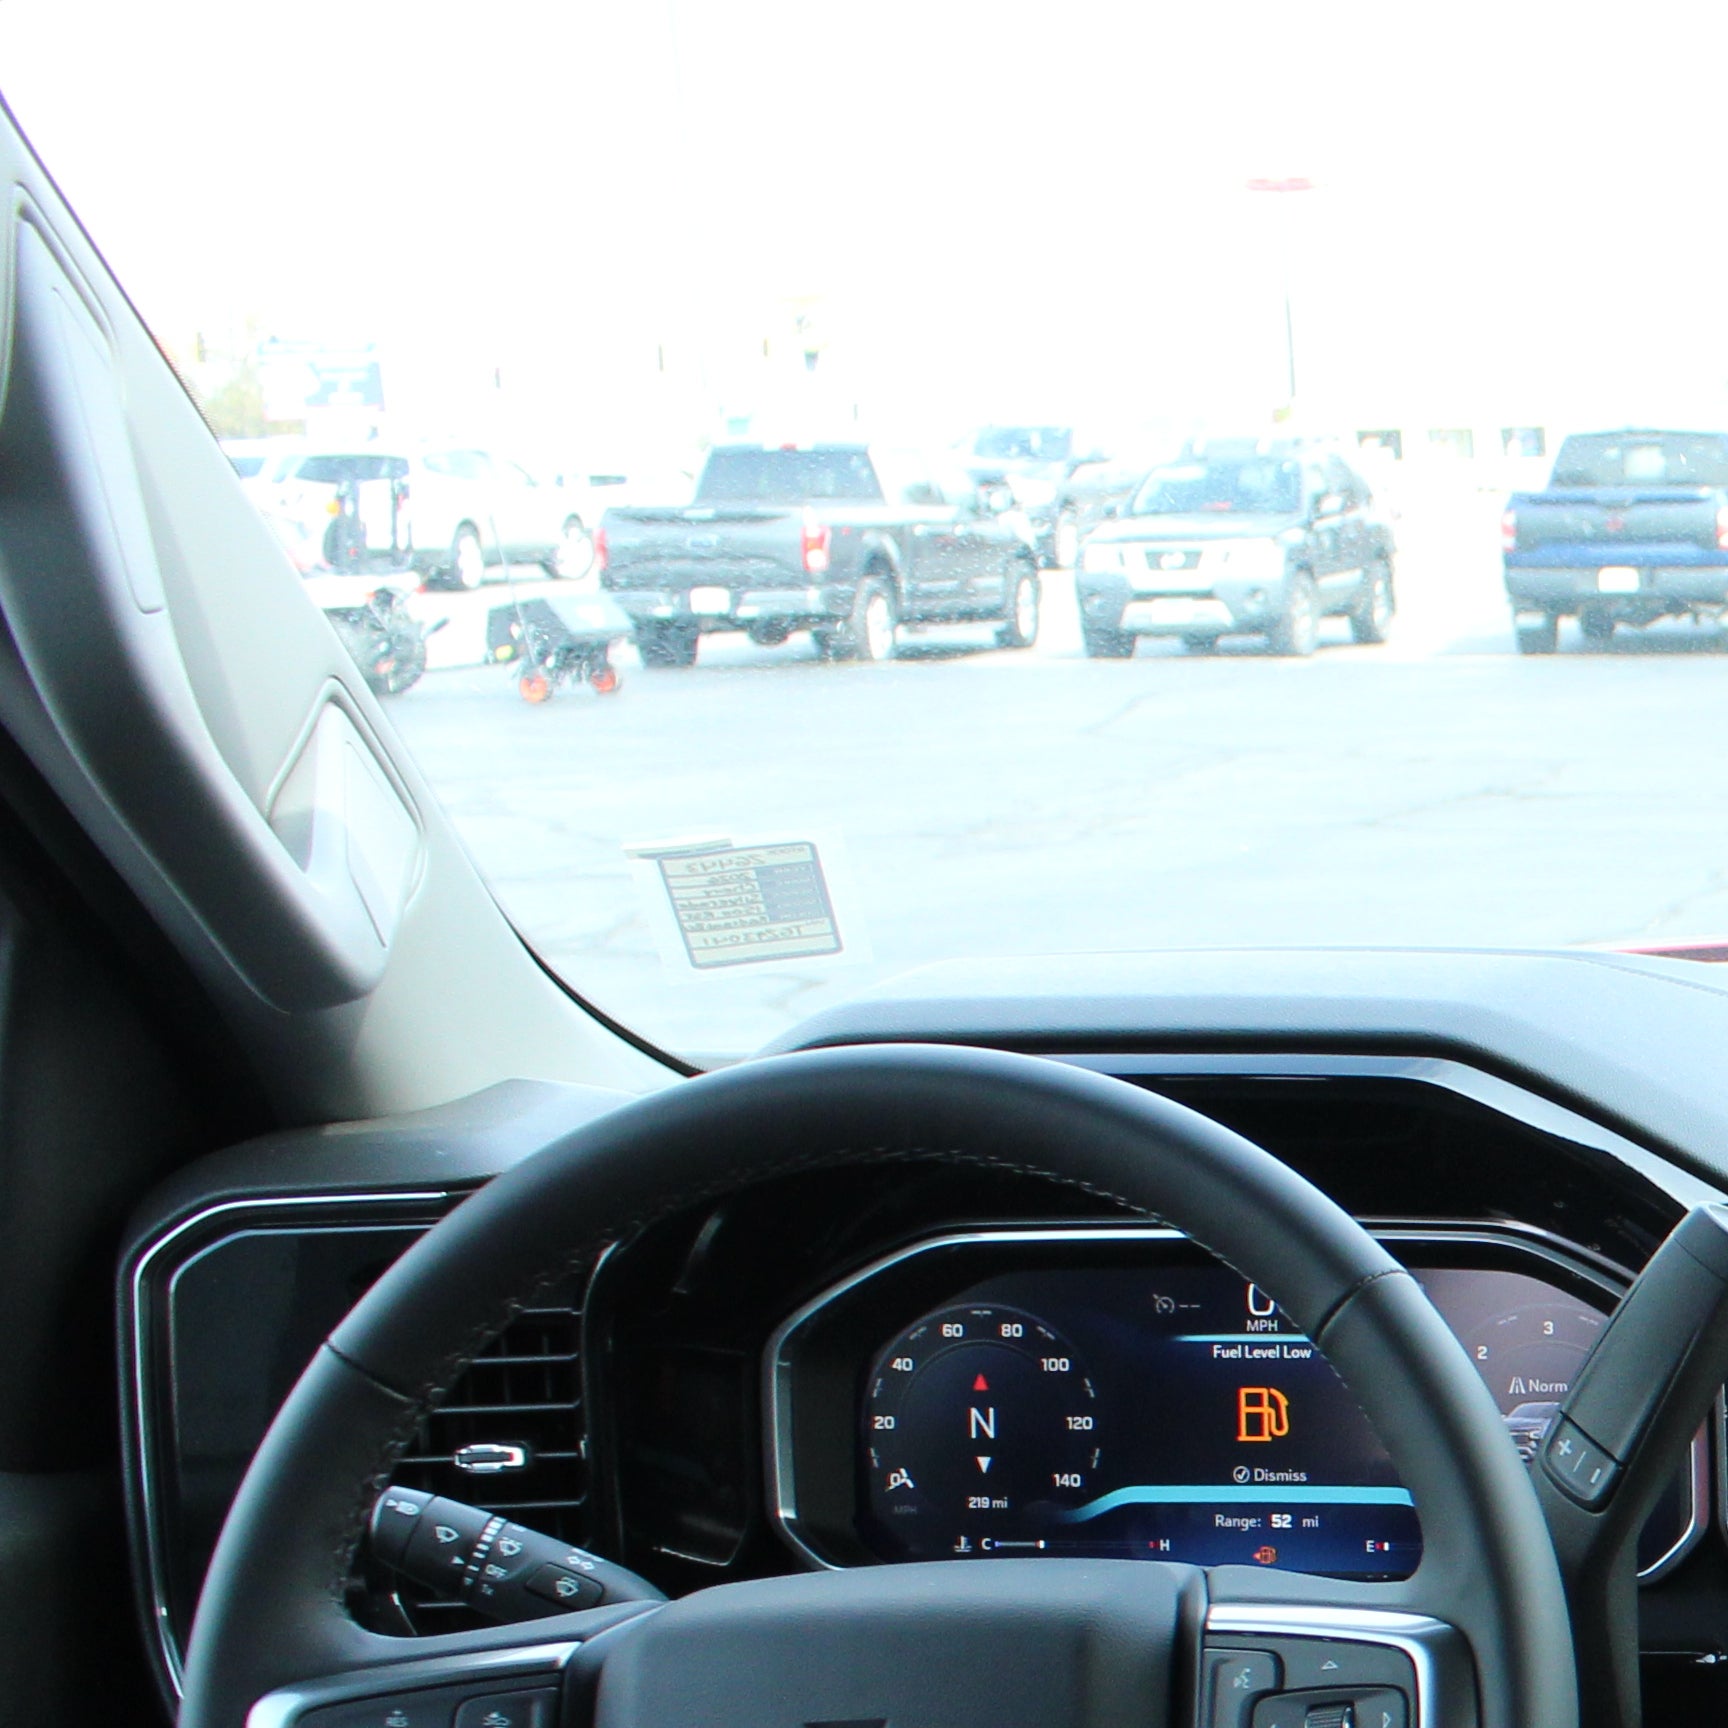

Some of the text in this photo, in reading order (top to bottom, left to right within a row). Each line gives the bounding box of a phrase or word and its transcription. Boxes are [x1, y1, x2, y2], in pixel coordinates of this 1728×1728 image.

[942, 1324, 1022, 1337] 60 80
[1246, 1319, 1278, 1332] MPH
[1543, 1321, 1554, 1335] 3
[1213, 1345, 1312, 1359] Fuel Level Low
[1477, 1345, 1488, 1360] 2
[892, 1358, 1069, 1371] 40 100
[875, 1408, 1093, 1438] 20 N 120
[1054, 1474, 1081, 1487] 140
[1255, 1468, 1307, 1481] Dismiss
[968, 1497, 1008, 1508] 219 mi
[1216, 1515, 1318, 1531] Range: 52 mi
[981, 1538, 992, 1550] C
[1160, 1540, 1170, 1551] H
[1366, 1540, 1375, 1552] E
